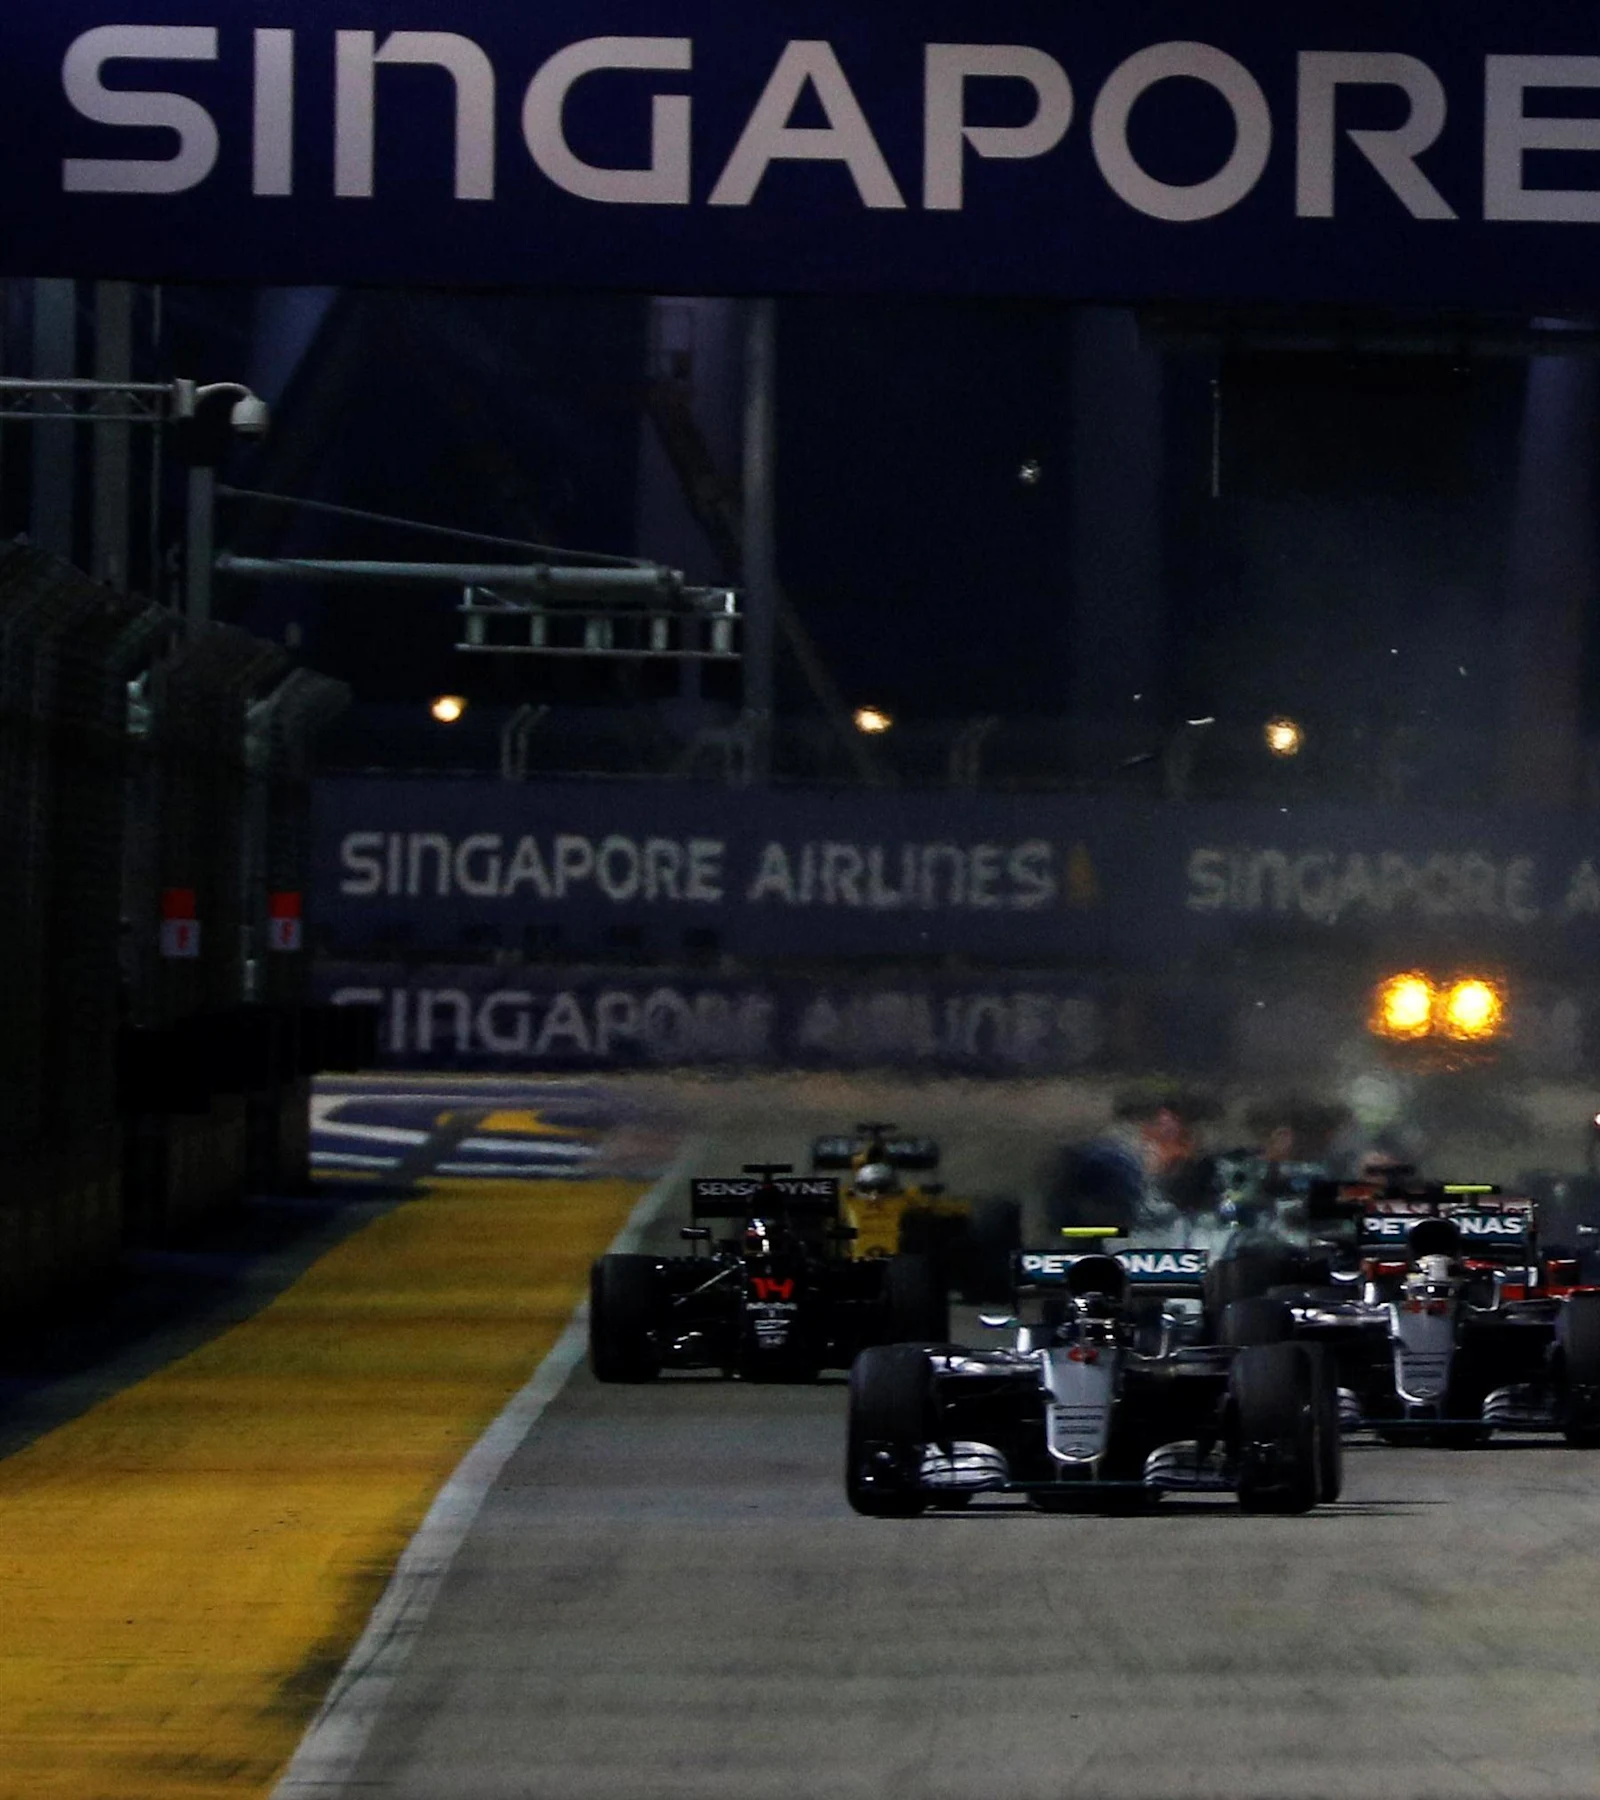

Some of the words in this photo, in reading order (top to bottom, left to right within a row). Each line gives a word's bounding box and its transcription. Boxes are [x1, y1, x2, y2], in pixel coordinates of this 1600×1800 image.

[339, 830, 724, 902] SINGAPORE
[746, 838, 1058, 910] AIRLINES
[330, 988, 770, 1056] INGAPORE
[1362, 1216, 1522, 1235] PETNAS
[1021, 1254, 1202, 1273] PENAS
